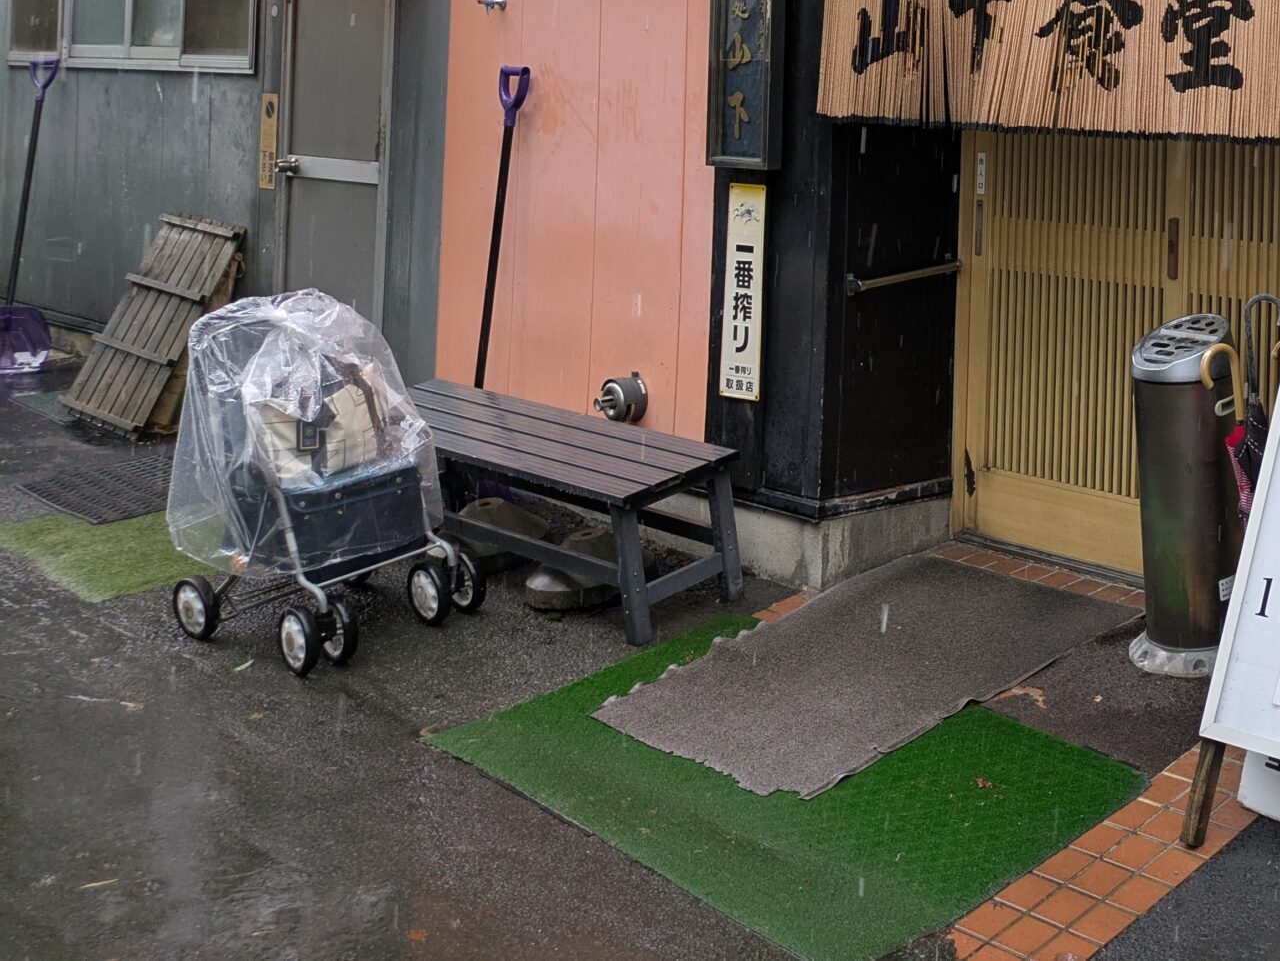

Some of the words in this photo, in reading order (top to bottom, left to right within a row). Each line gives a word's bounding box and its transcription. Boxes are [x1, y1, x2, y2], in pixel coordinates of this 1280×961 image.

[732, 244, 754, 353] 一番搾り
[728, 365, 752, 376] 一番搾り
[725, 377, 754, 393] 取扱店
